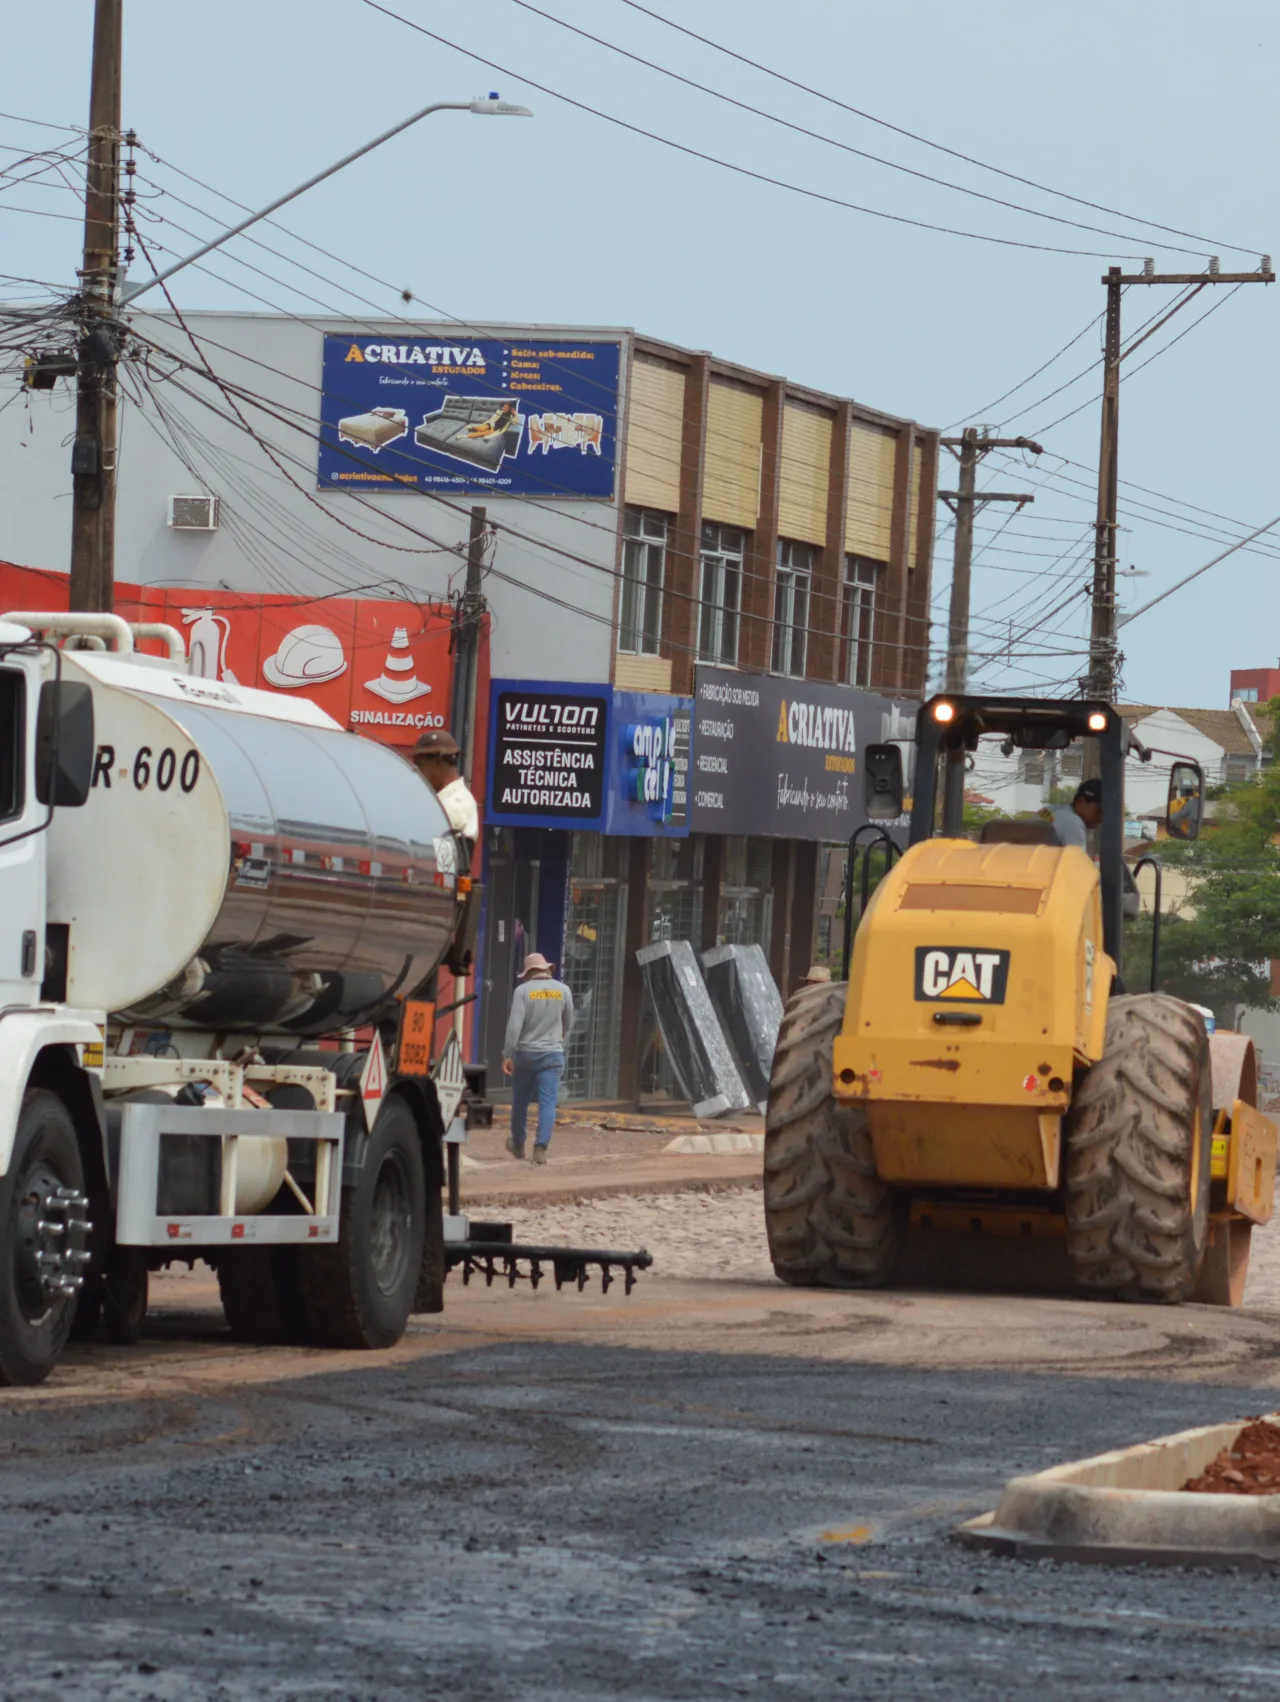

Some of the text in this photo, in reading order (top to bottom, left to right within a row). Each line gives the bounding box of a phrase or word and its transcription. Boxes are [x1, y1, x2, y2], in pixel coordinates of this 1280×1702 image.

[432, 366, 486, 375] ESTOFADOS
[702, 683, 732, 707] FABRICAÇÃO
[742, 689, 759, 706] MEDIDA
[350, 709, 445, 730] SINALIZAÇÃO
[504, 702, 599, 726] VULTON
[506, 723, 546, 732] PATINETES
[557, 726, 596, 735] SCOOTERS
[701, 719, 734, 742] RESTAURAÇÃO
[503, 748, 595, 769] ASSISTÊNCIA
[519, 767, 577, 788] TÉCNICA
[502, 788, 592, 808] AUTORIZADA
[697, 791, 724, 808] COMERCIAL
[922, 950, 1000, 1000] CAT
